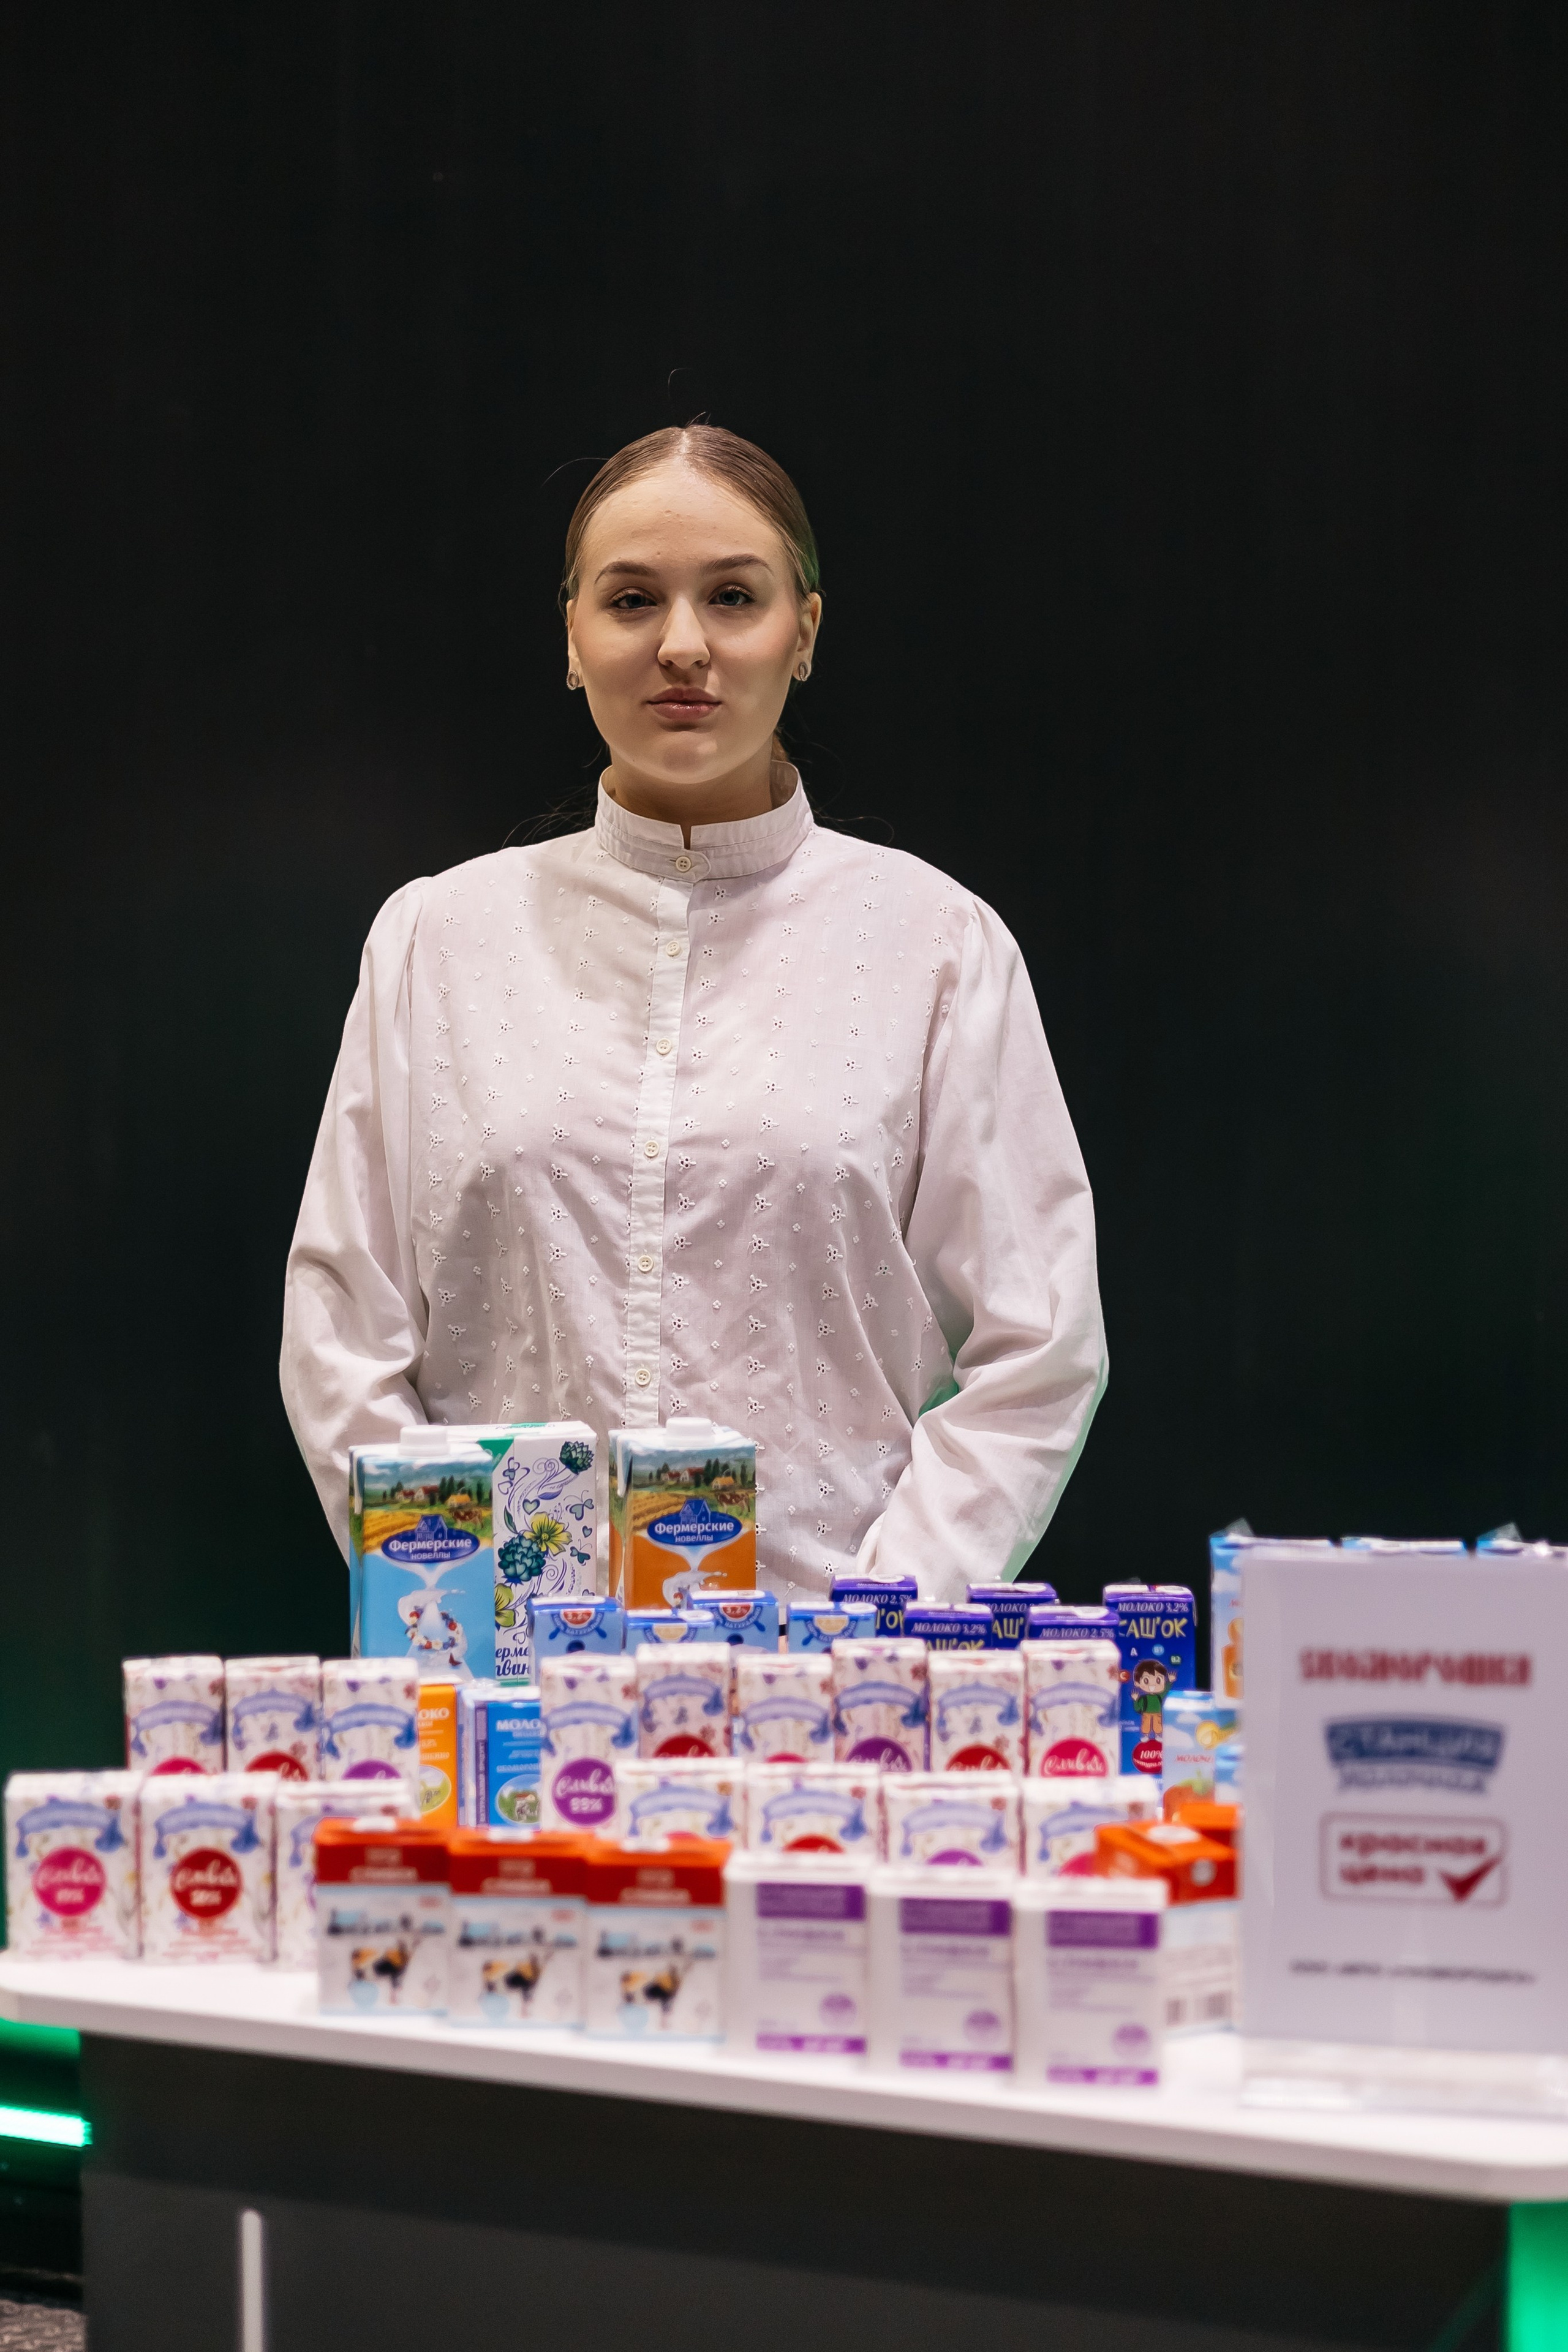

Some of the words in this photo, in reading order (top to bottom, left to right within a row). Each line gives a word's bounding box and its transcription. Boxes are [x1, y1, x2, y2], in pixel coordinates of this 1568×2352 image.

[655, 1522, 734, 1535] Фермерские
[389, 1539, 472, 1552] Фермерские
[1117, 1602, 1163, 1612] МОЛОКО
[1166, 1602, 1189, 1612] 3,2%
[911, 1623, 960, 1634] МОЛОКО
[1041, 1627, 1088, 1638] МОЛОКО
[496, 1718, 541, 1732] МОЛО
